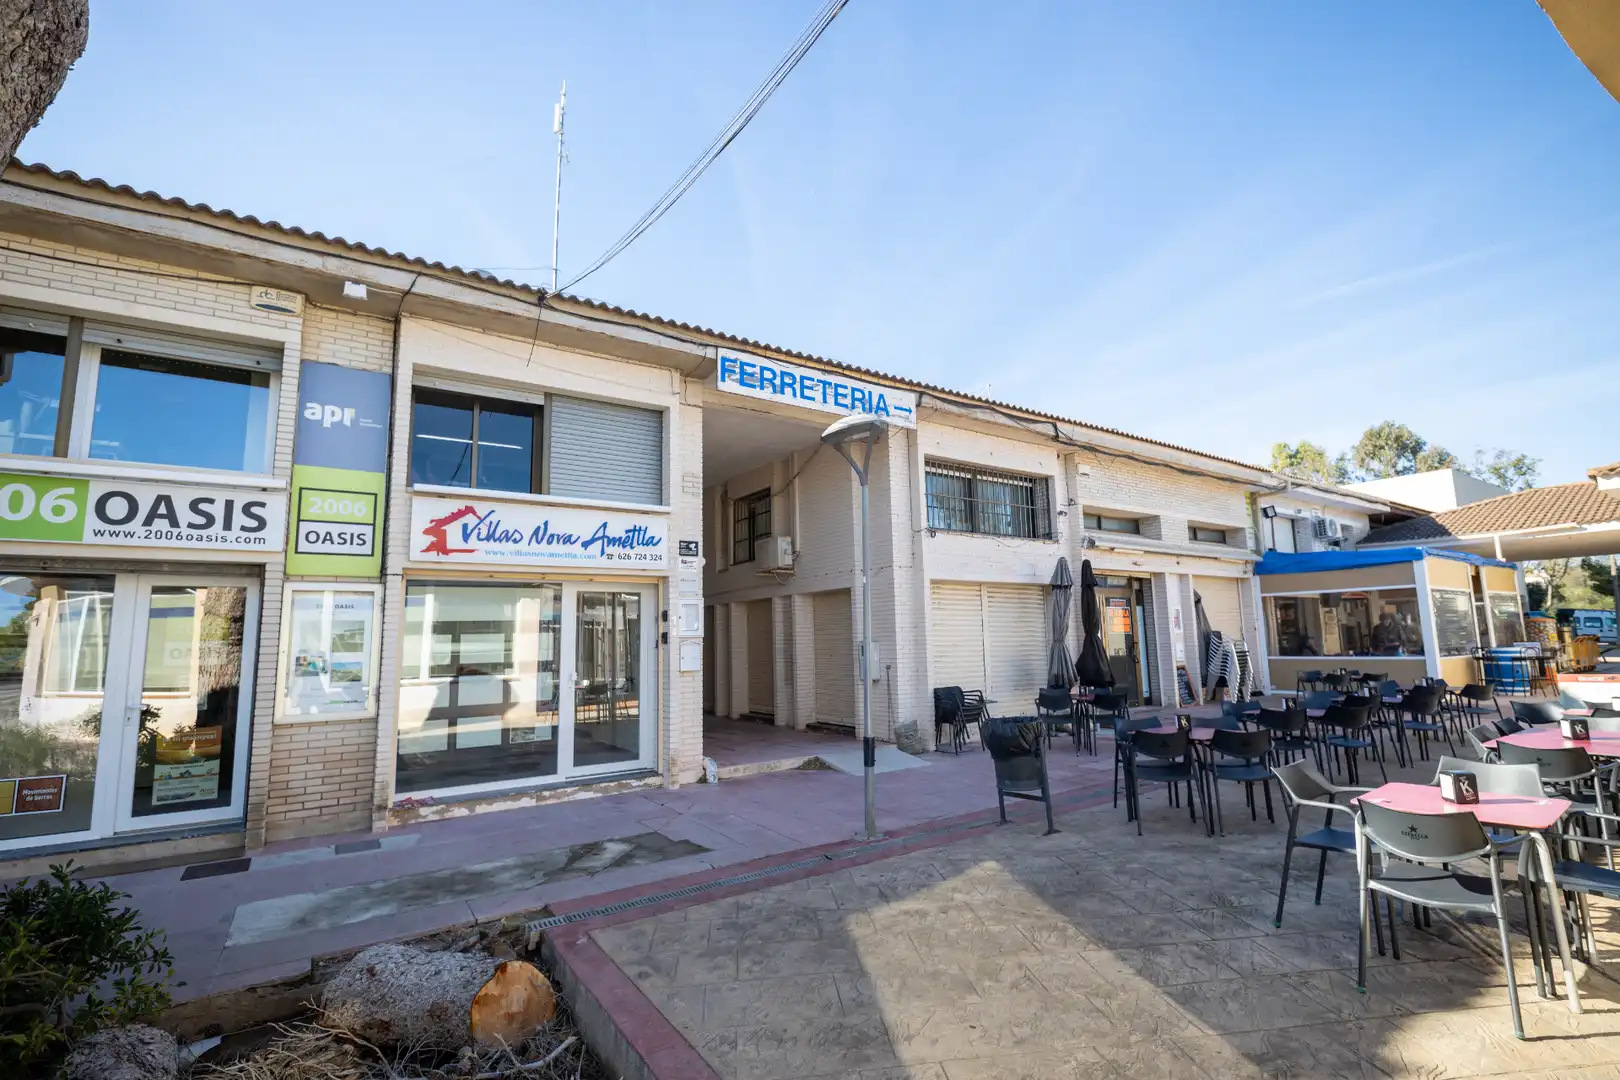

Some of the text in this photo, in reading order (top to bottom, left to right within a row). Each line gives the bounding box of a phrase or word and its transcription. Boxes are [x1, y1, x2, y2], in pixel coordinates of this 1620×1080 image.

[720, 356, 890, 417] FERRETERIA
[304, 402, 355, 428] apr
[94, 490, 268, 533] OASIS
[308, 497, 367, 517] 2006
[93, 528, 266, 545] www.2006oasis.com
[304, 530, 367, 546] OASIS
[461, 510, 523, 544] Villas
[528, 520, 580, 546] Nova
[617, 552, 632, 560] 626
[649, 553, 662, 561] 324
